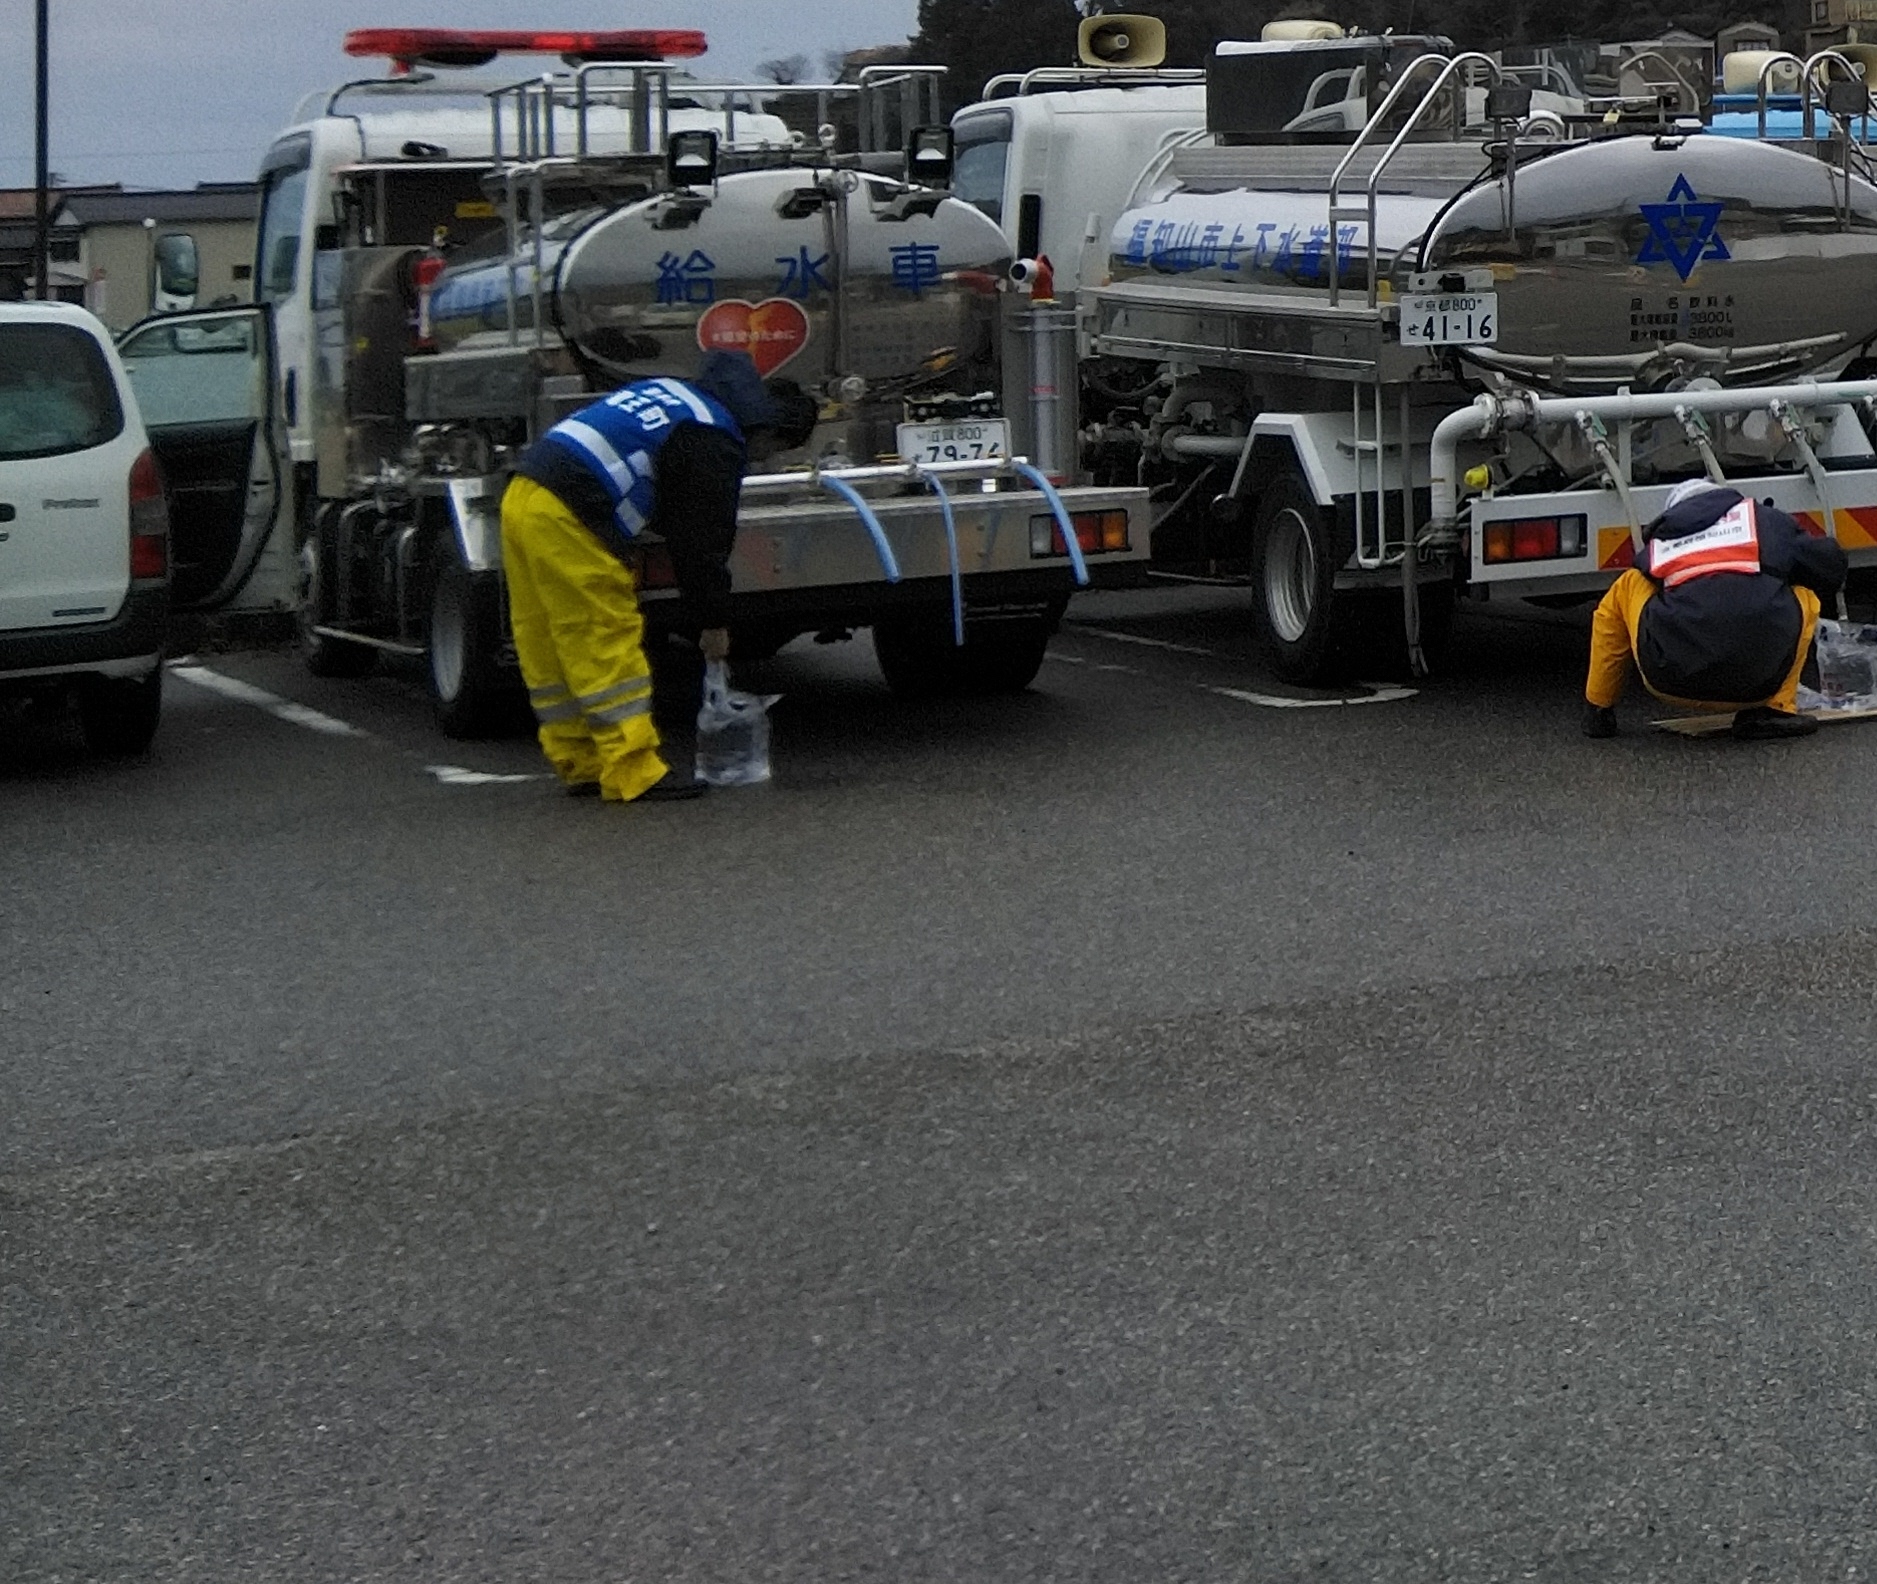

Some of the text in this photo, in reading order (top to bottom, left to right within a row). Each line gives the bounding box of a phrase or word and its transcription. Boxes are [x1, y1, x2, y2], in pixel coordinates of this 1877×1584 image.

[655, 242, 940, 305] 給水車
[1422, 314, 1492, 341] 41-16
